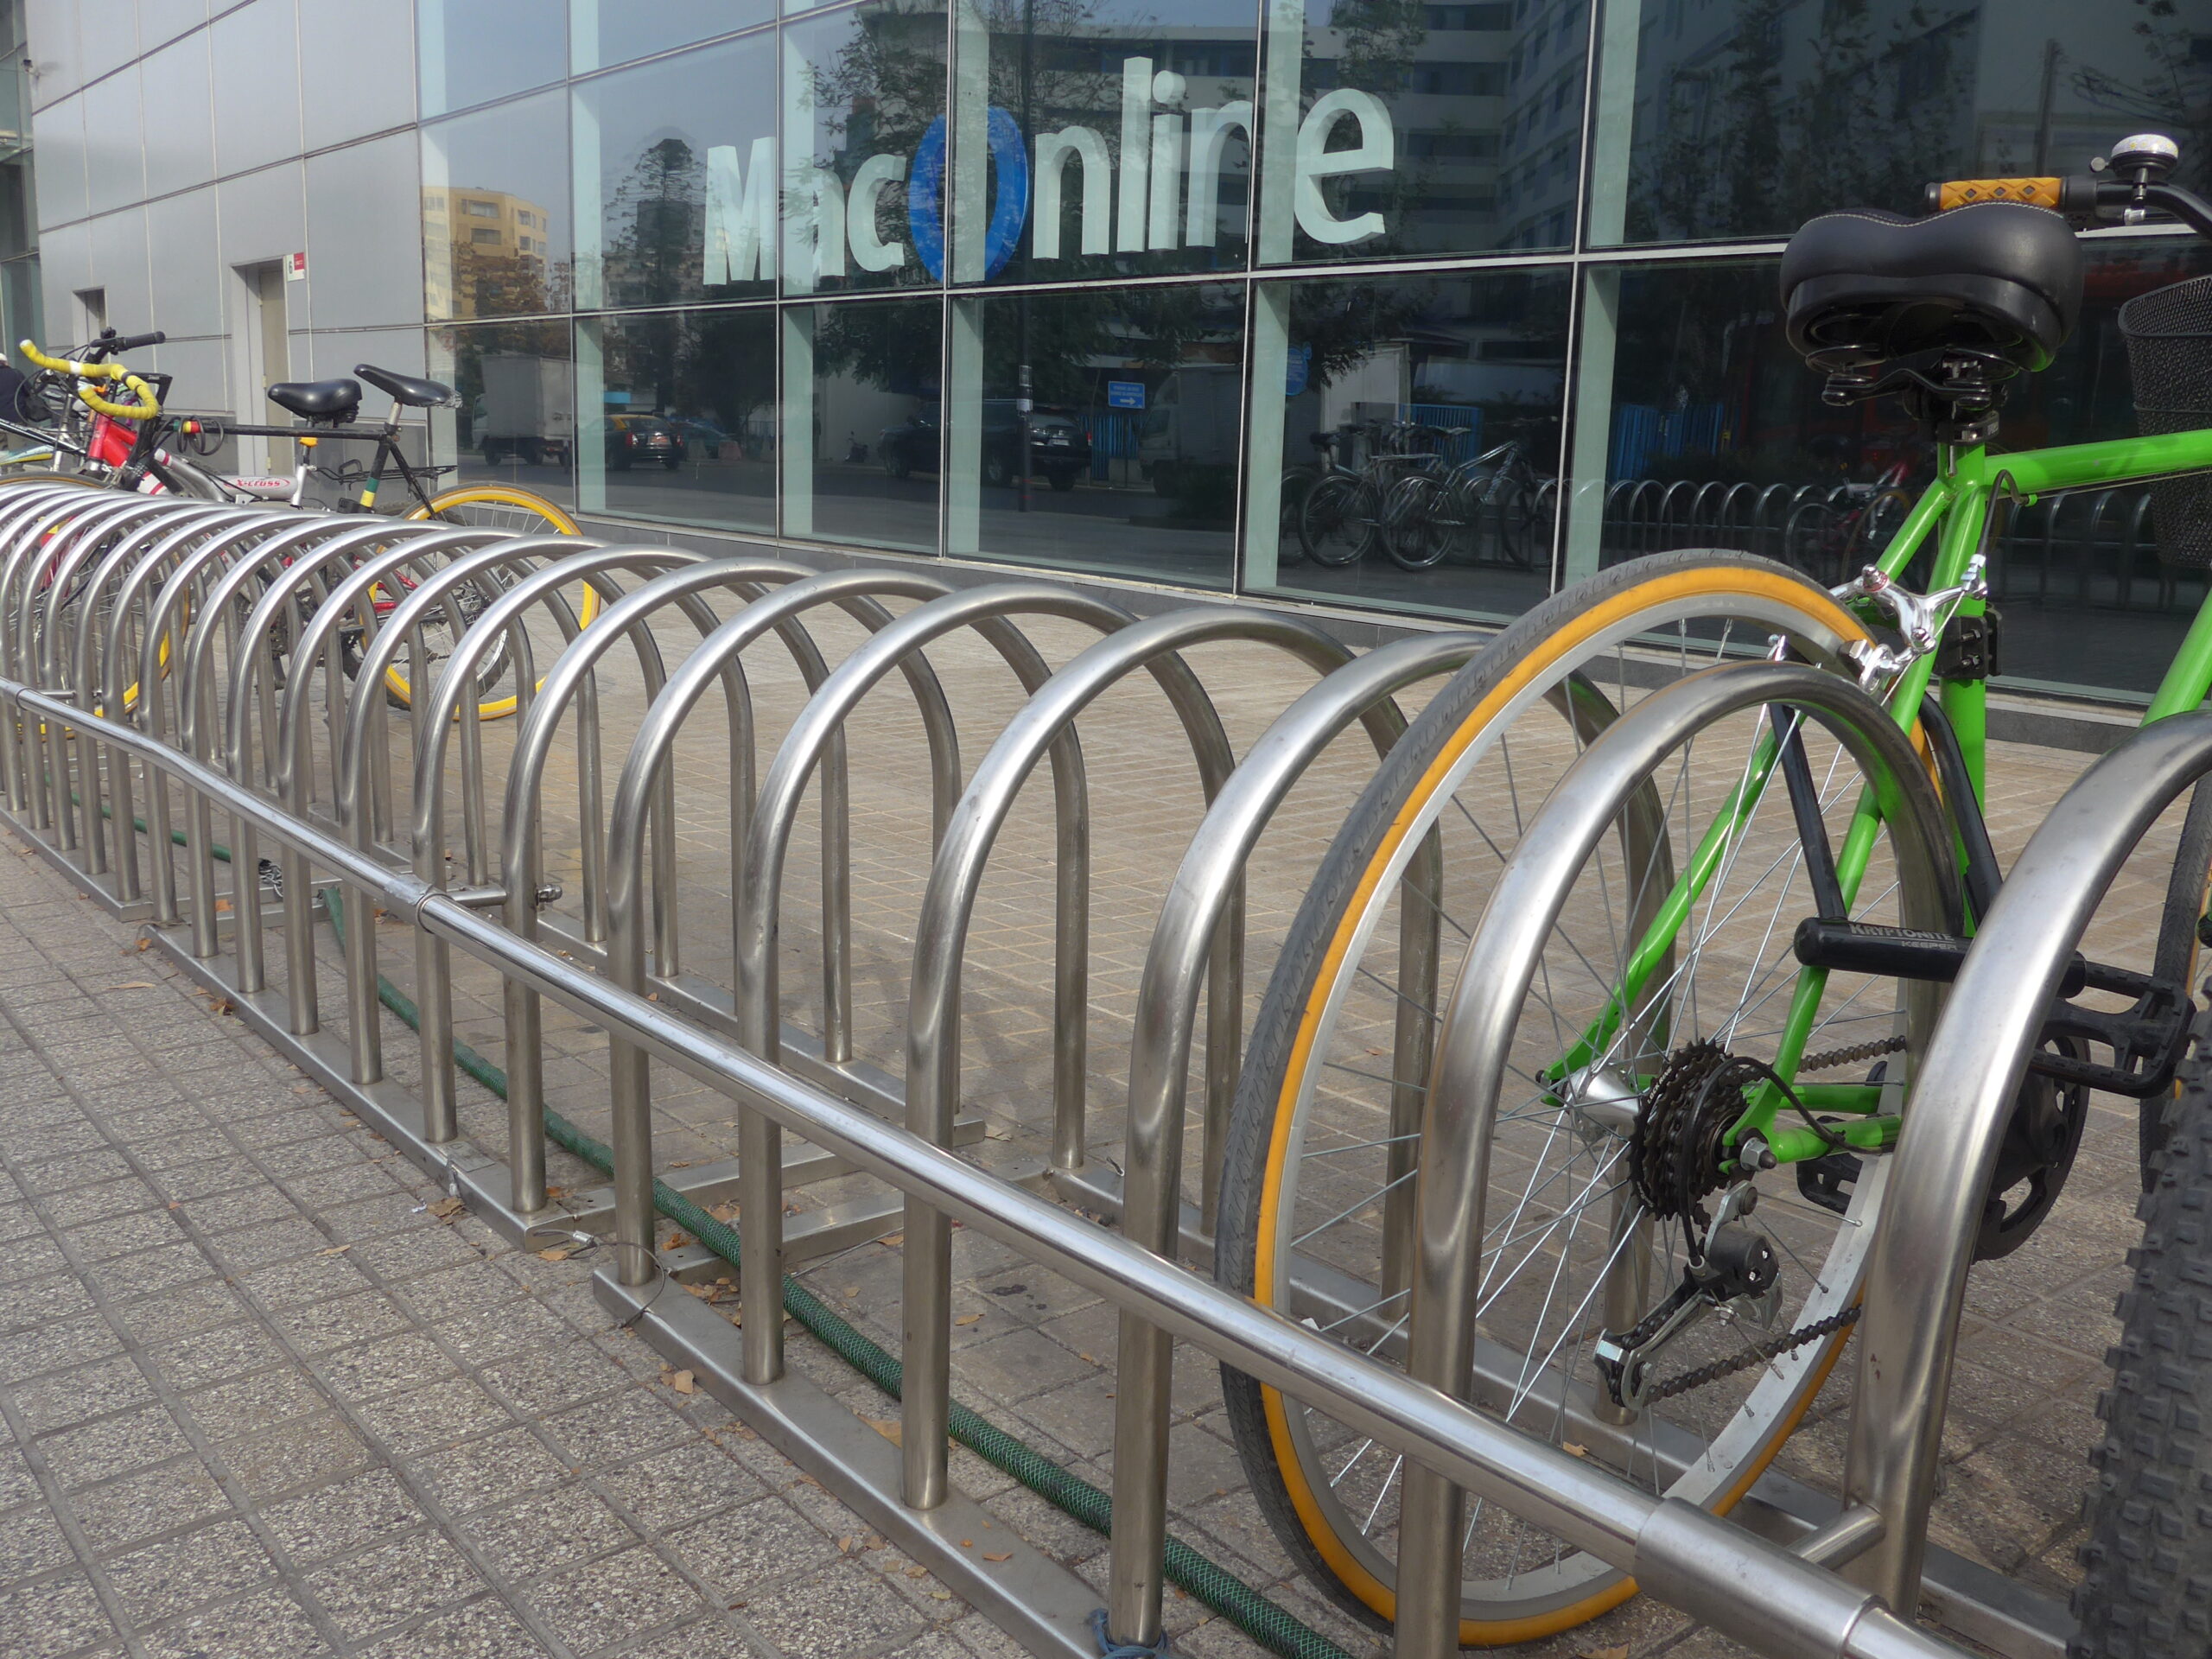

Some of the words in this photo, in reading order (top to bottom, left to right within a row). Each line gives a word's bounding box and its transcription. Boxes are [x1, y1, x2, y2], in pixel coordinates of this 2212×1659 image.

[703, 56, 1395, 286] MacOnline
[1851, 925, 1955, 941] KRYPTONITE
[1902, 942, 1958, 951] KEEPER
